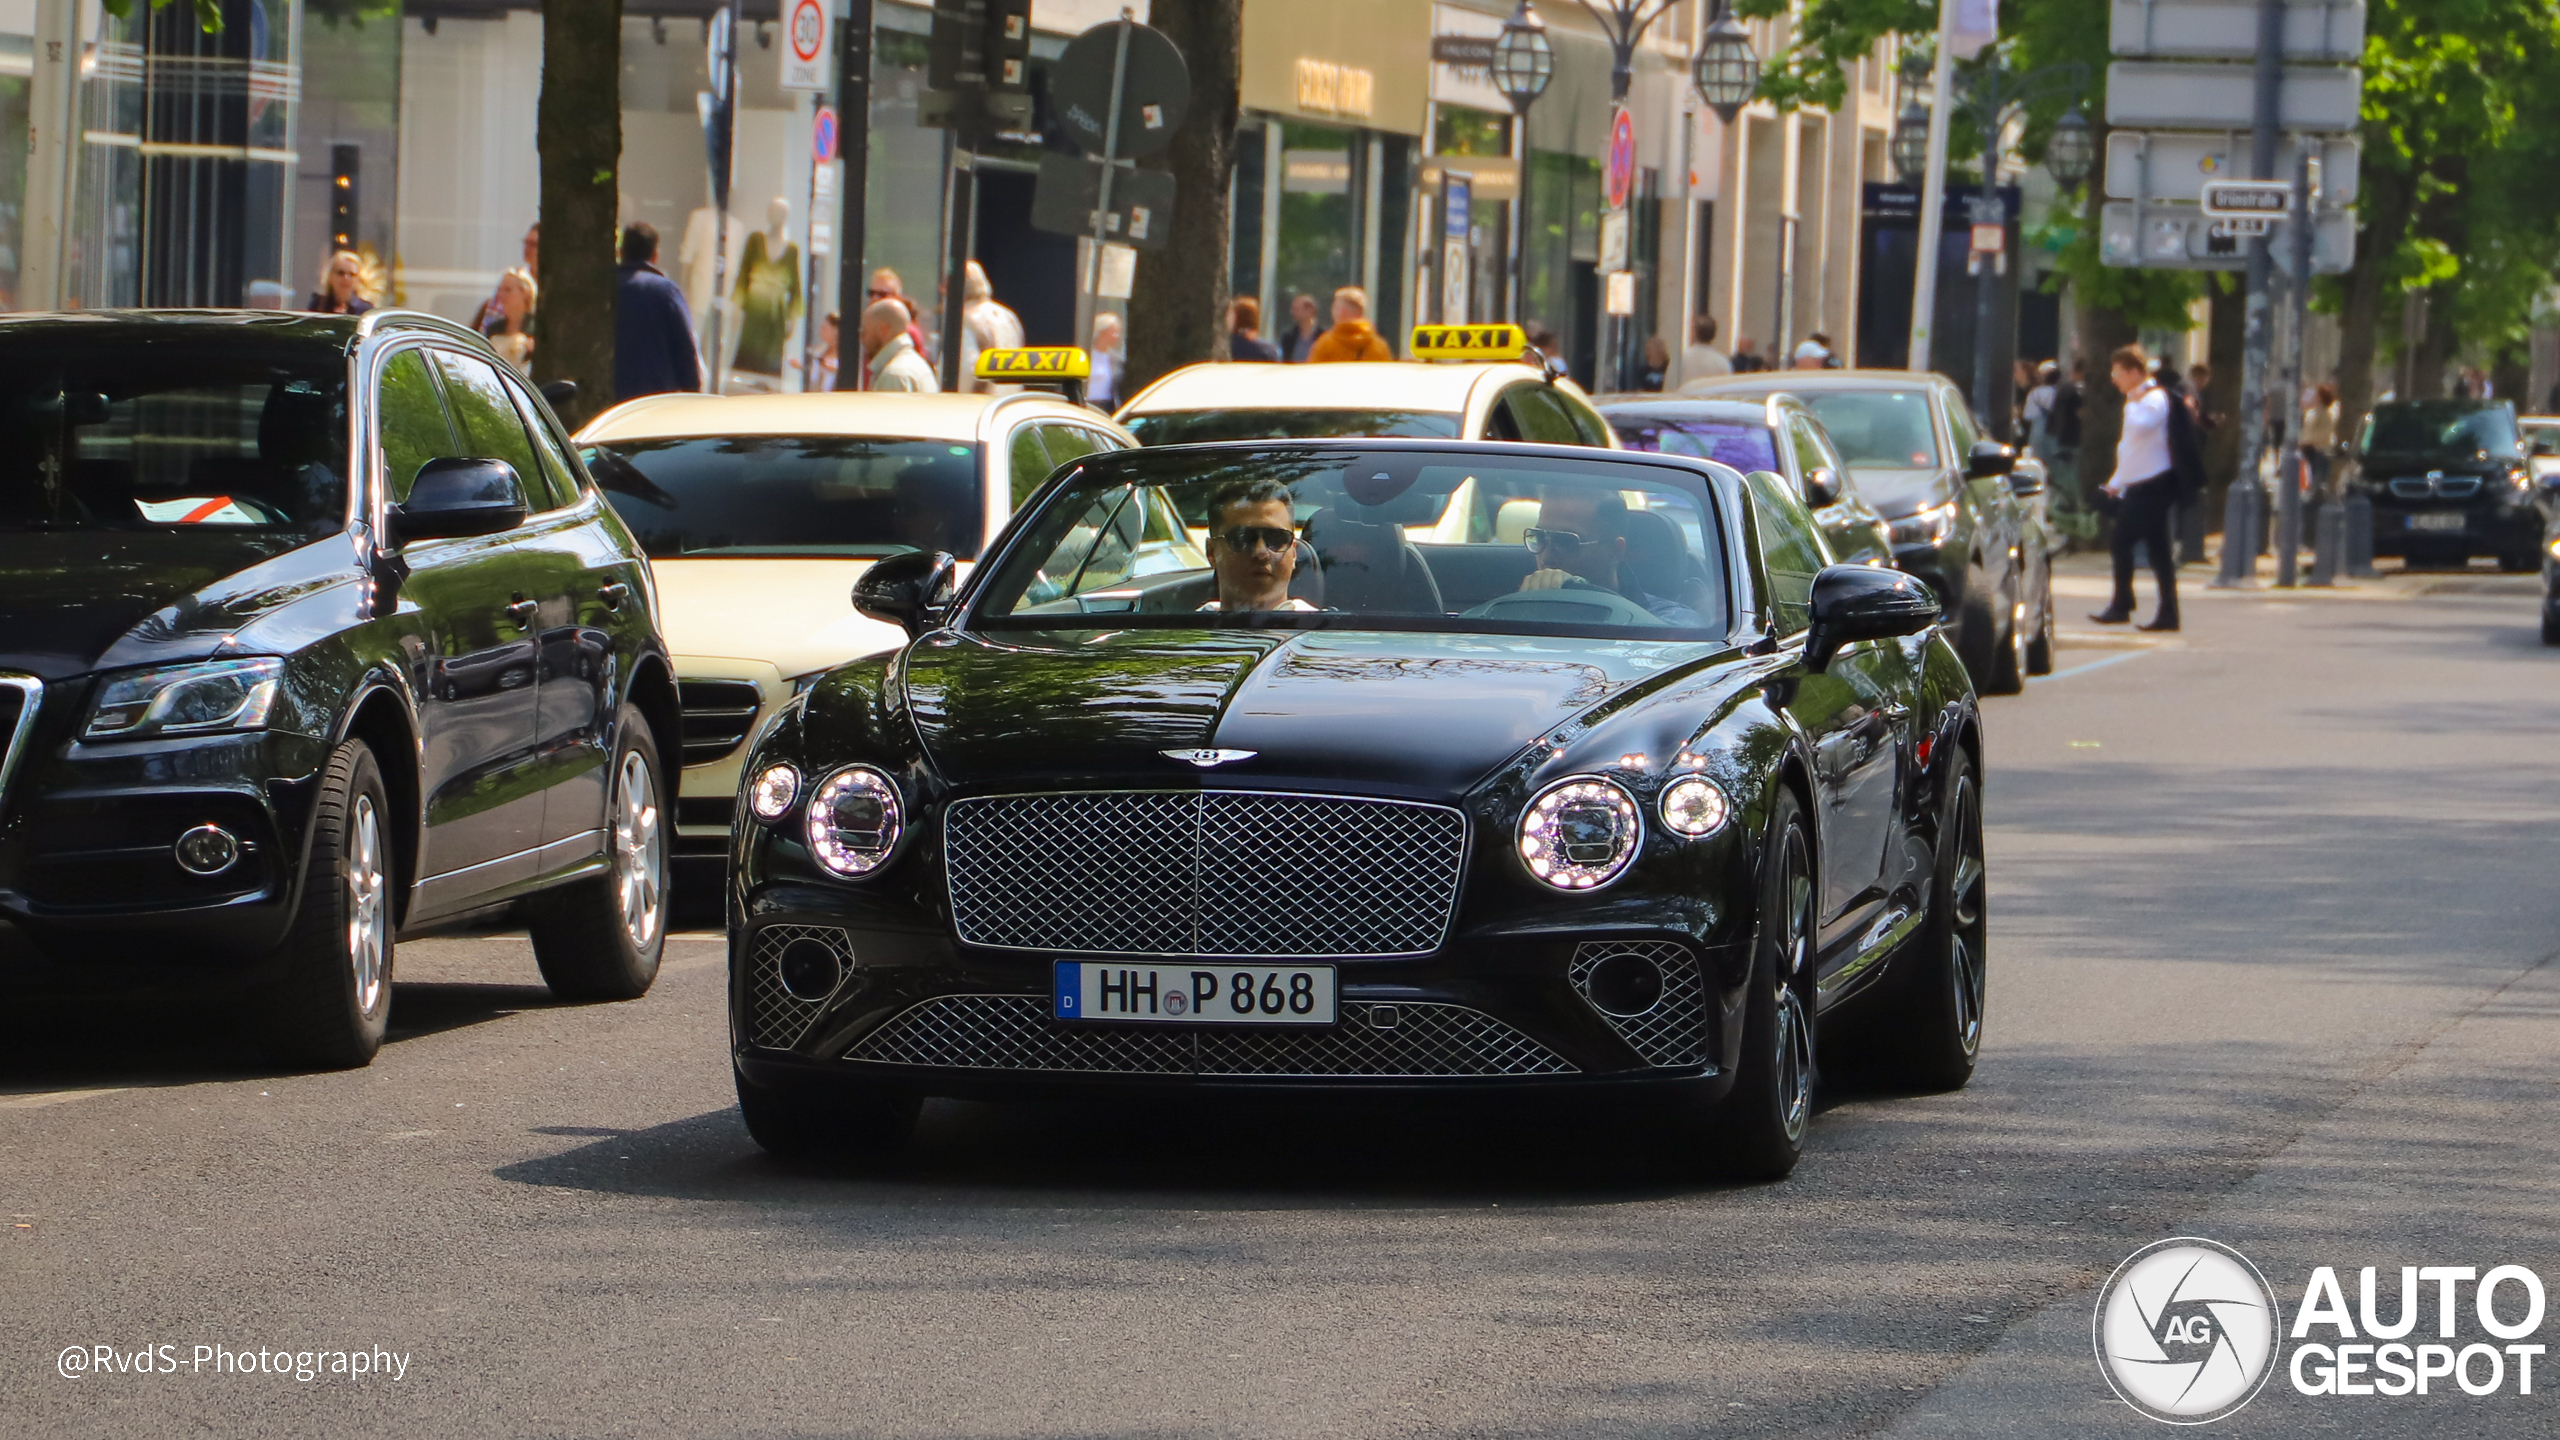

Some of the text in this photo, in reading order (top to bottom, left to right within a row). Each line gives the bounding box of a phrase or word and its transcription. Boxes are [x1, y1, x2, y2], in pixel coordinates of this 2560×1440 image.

[796, 15, 818, 44] 30
[792, 66, 817, 83] ZONE
[1426, 330, 1499, 348] TAXI
[993, 352, 1068, 370] TAXI
[1100, 969, 1315, 1015] HH P 868
[1063, 995, 1073, 1008] D
